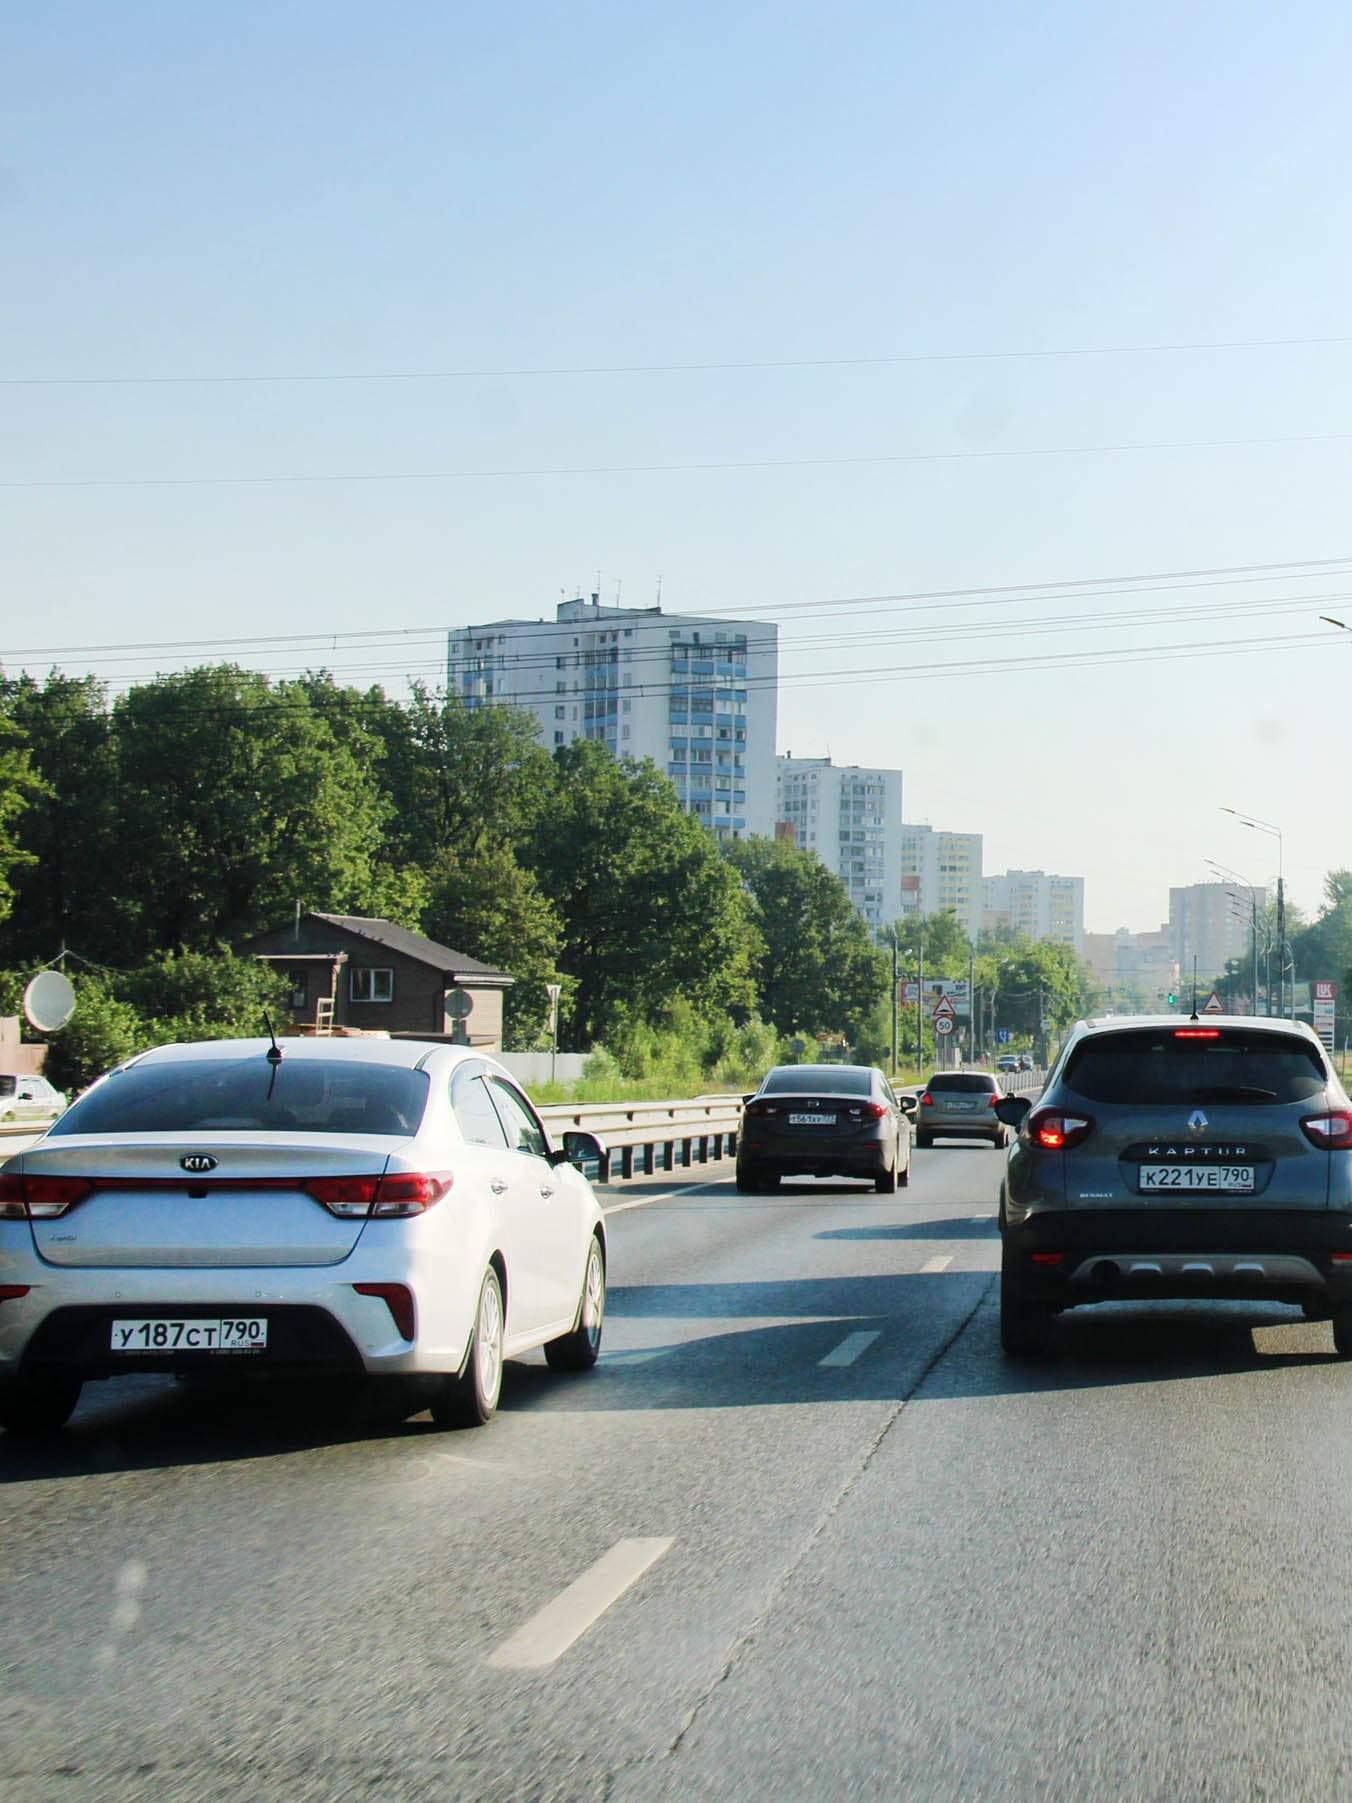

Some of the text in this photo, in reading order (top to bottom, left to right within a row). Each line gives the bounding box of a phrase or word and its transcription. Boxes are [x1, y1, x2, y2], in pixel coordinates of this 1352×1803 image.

[938, 1021, 950, 1031] 50
[1148, 1147, 1247, 1155] KAPTUR
[184, 1157, 212, 1169] KIA
[1222, 1168, 1250, 1182] 790
[223, 1321, 260, 1339] 790
